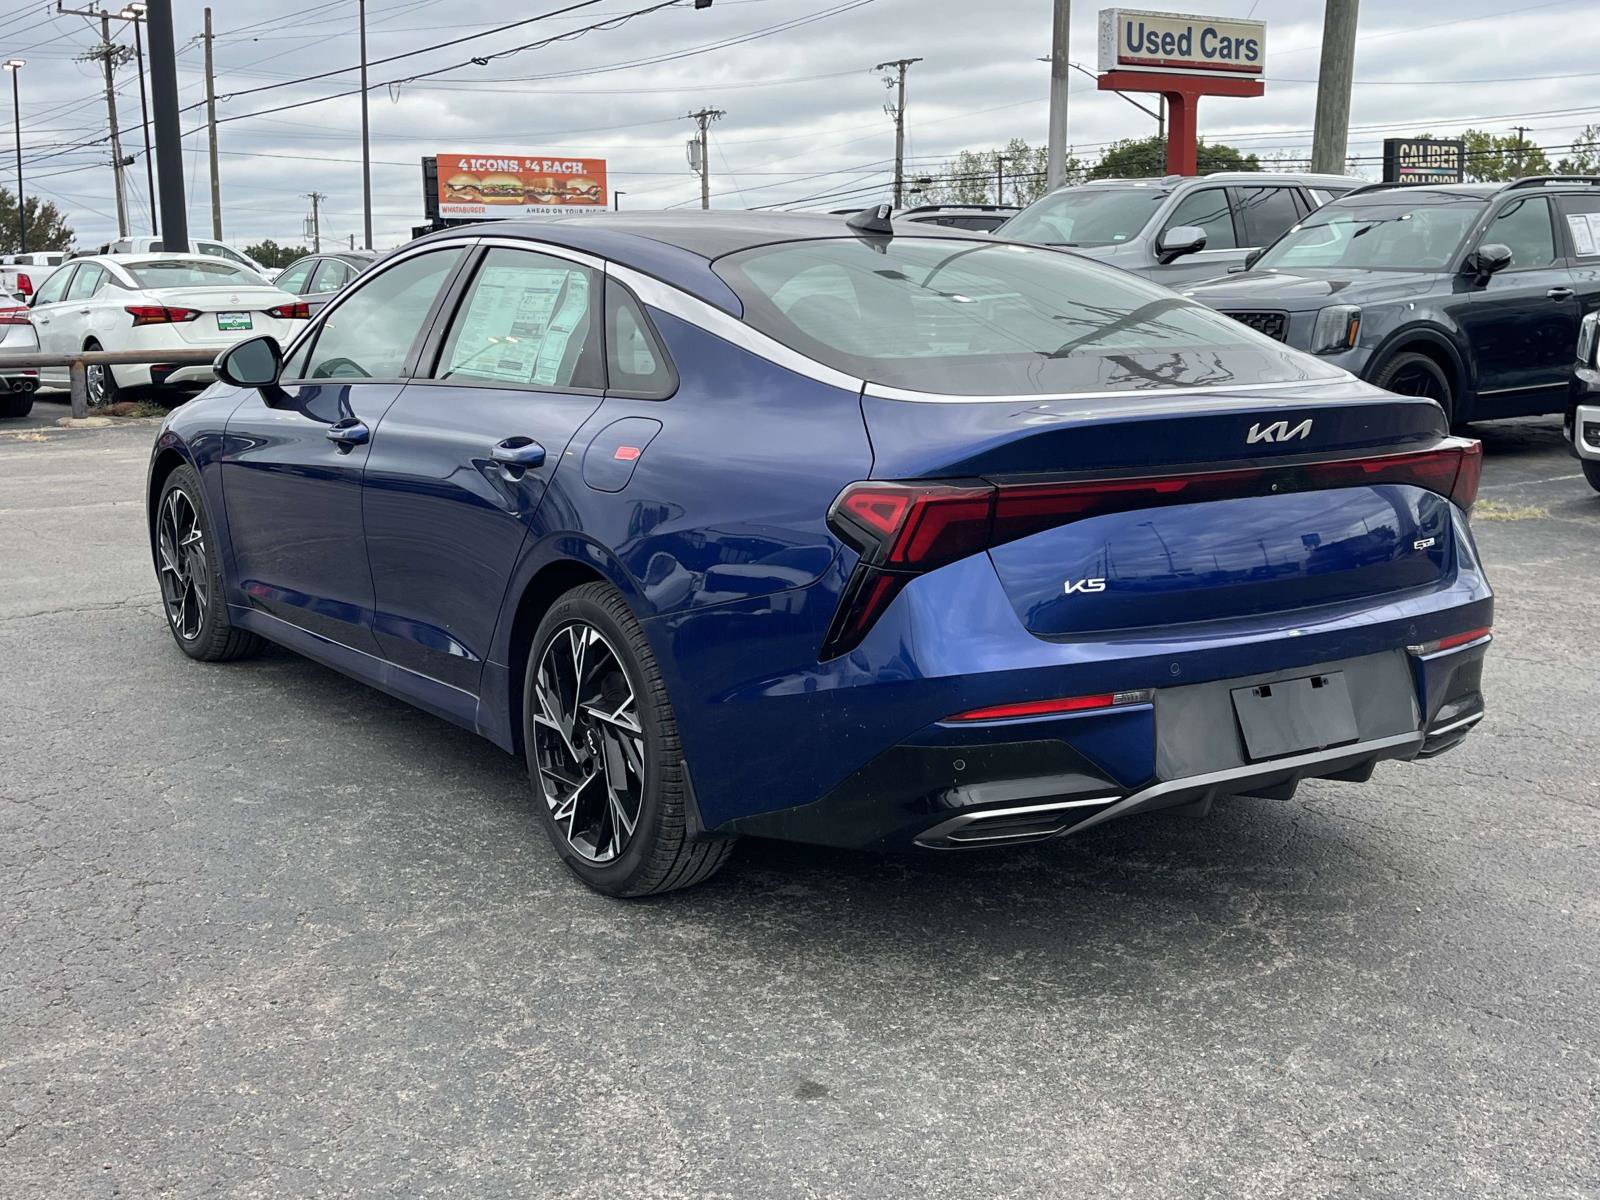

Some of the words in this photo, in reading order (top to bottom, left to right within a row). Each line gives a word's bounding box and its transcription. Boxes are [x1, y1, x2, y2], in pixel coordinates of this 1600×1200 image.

[1126, 21, 1192, 57] Used
[1200, 27, 1259, 61] Cars
[1400, 143, 1458, 168] CALIBER
[458, 159, 468, 172] 4
[470, 159, 524, 173] ICONS.
[525, 160, 540, 173] $4
[542, 160, 587, 174] EACH.
[441, 205, 486, 214] WHATABURGER
[1246, 419, 1313, 444] KIA
[1064, 578, 1106, 594] K5
